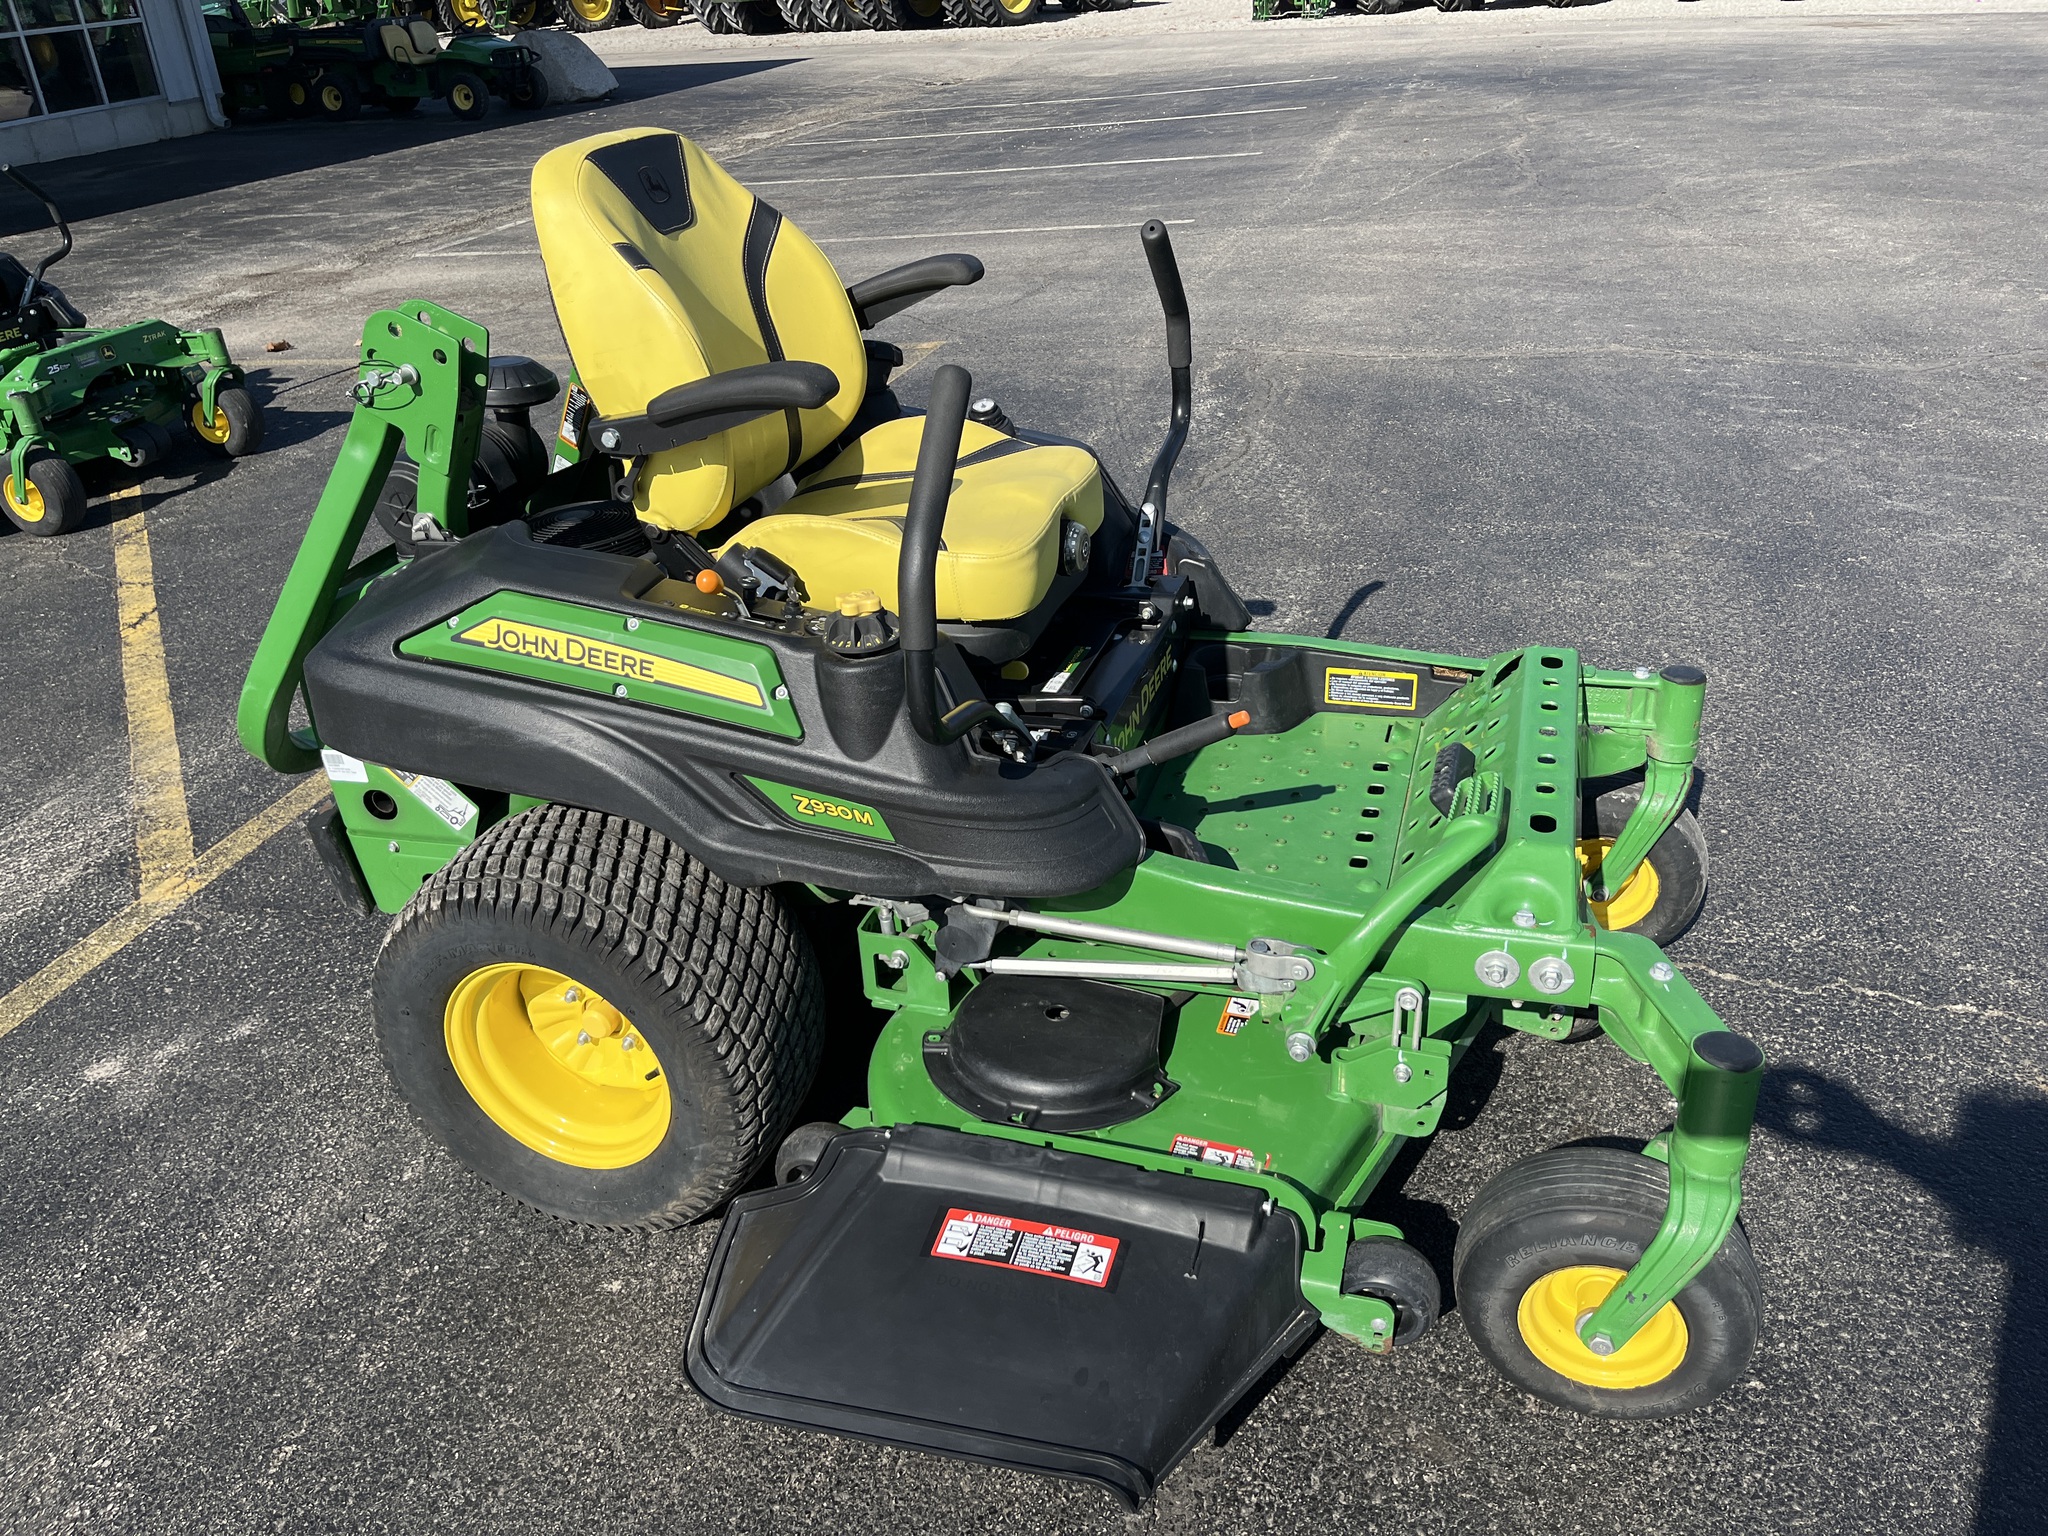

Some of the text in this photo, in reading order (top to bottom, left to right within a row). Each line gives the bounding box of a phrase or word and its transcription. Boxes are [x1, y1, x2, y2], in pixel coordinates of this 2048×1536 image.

[142, 330, 167, 344] ZTRAK
[47, 363, 60, 375] 25
[486, 623, 656, 680] JOHN DEERE
[1140, 644, 1173, 715] DEERE
[793, 794, 875, 828] Z930M
[1182, 1136, 1209, 1147] DANGER
[974, 1214, 1012, 1228] DANGER
[1054, 1228, 1095, 1244] PELIGRO
[1504, 1232, 1638, 1269] RELIANCE
